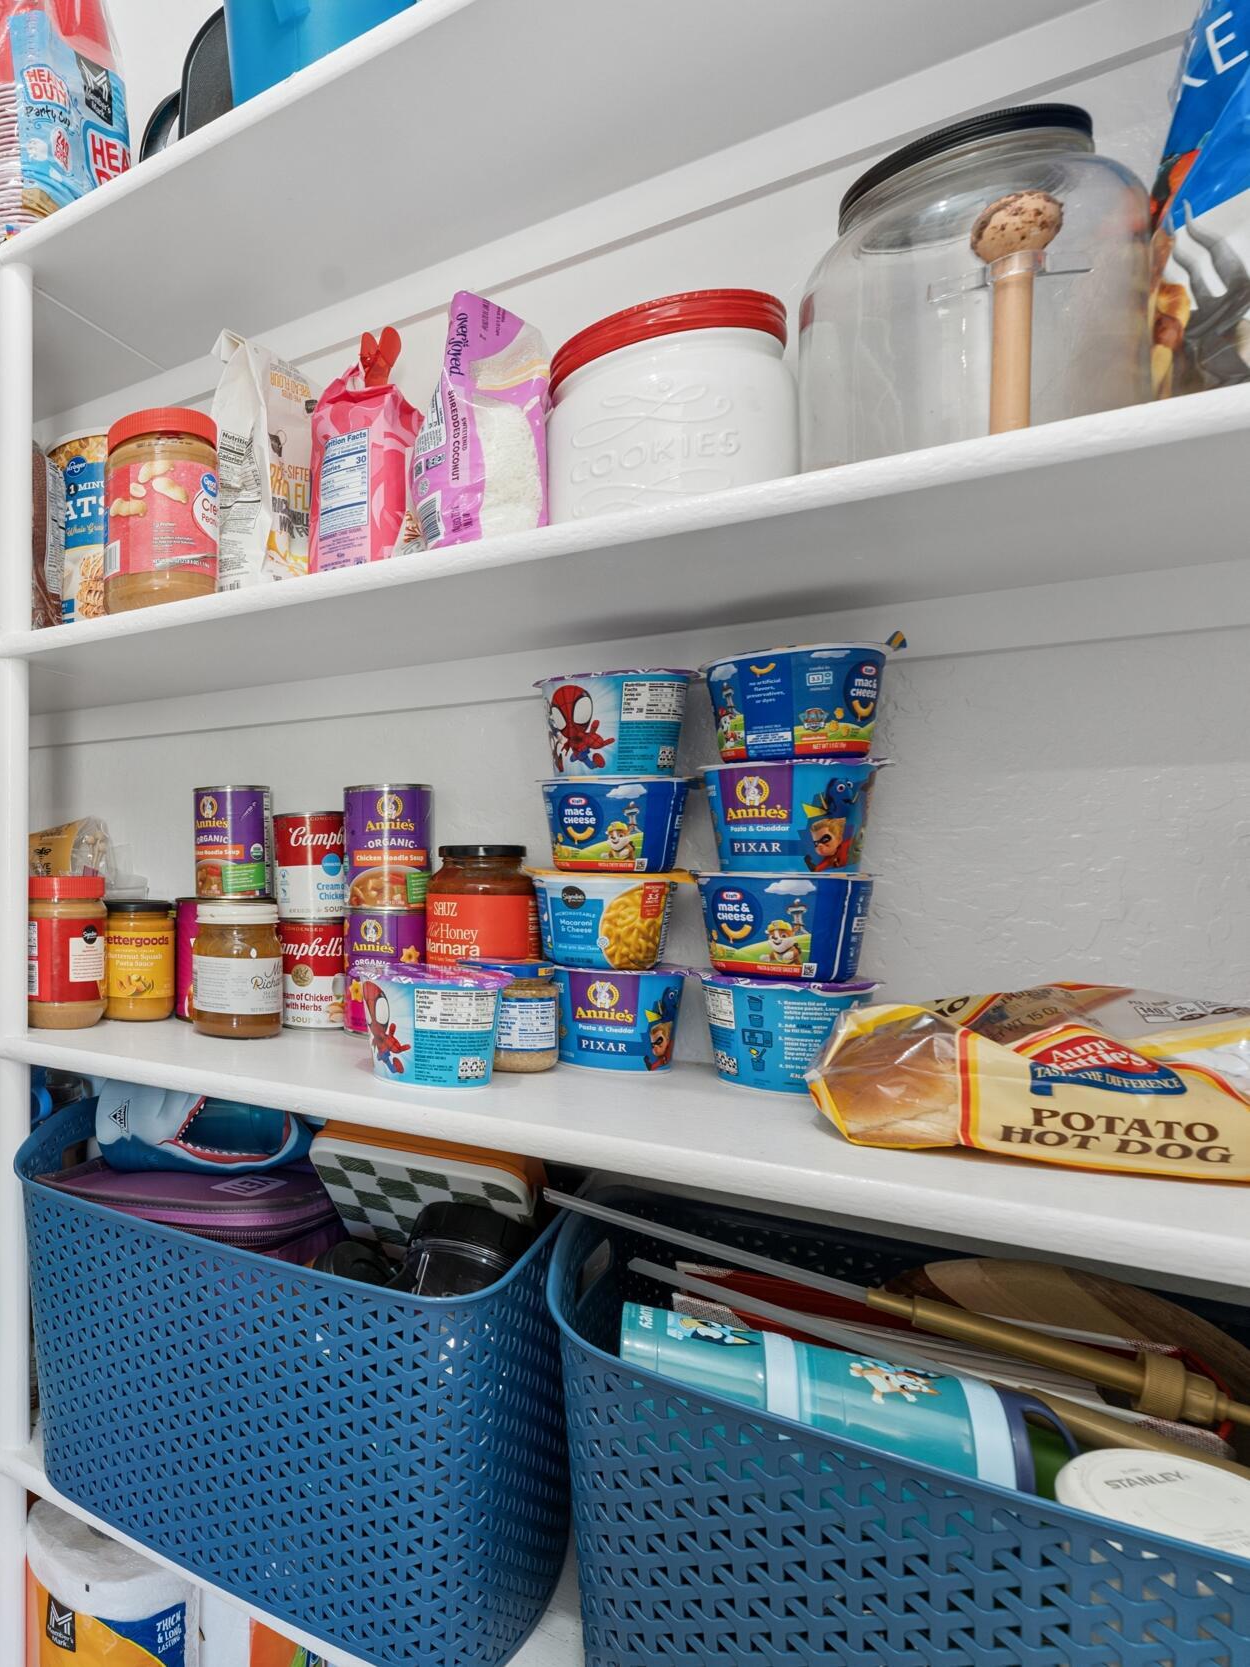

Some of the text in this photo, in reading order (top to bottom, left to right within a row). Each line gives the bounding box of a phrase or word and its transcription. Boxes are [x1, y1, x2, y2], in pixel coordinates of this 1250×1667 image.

[347, 431, 367, 442] Facts
[448, 391, 460, 481] SHREDDED COCONUT
[356, 455, 367, 465] 30
[570, 429, 743, 487] COOKIES
[66, 460, 87, 473] Kroger
[755, 677, 781, 686] artificial
[854, 678, 872, 687] mac
[564, 807, 594, 817] mac &
[726, 803, 789, 821] Annie's
[196, 818, 229, 829] Annie's
[365, 818, 415, 832] Annie's
[756, 824, 790, 833] Cheddar
[196, 834, 230, 844] ORGANIC
[367, 837, 416, 849] ORGANIC
[733, 842, 782, 853] PIXAR
[356, 854, 425, 862] Chicken Noodle Soup
[316, 882, 340, 891] Cream
[319, 892, 344, 901] Chicke
[433, 901, 458, 917] SAUZ
[717, 903, 751, 913] mac &
[559, 919, 593, 927] Macaroni
[440, 923, 479, 944] Honey
[566, 926, 593, 934] Cheese
[105, 934, 170, 947] ettergoods
[352, 941, 396, 955] Annie's
[296, 992, 333, 1002] of Chicken
[285, 1002, 323, 1012] with Herbs
[574, 1006, 635, 1023] Annie's
[1026, 1009, 1044, 1022] 15
[578, 1024, 596, 1032] Pasta
[605, 1025, 635, 1034] Cheddar
[581, 1039, 627, 1052] PIXAR
[1051, 1038, 1117, 1064] Aunt
[1105, 1071, 1182, 1089] DIFFERENCE
[1029, 1106, 1221, 1143] POTATO
[999, 1124, 1236, 1165] HOT DOG
[223, 1176, 278, 1194] YETI
[1103, 1469, 1185, 1490] STANLEY
[155, 1609, 182, 1630] THICK
[47, 1624, 75, 1645] Member's
[156, 1624, 183, 1644] & LONG
[157, 1634, 182, 1654] LASTING
